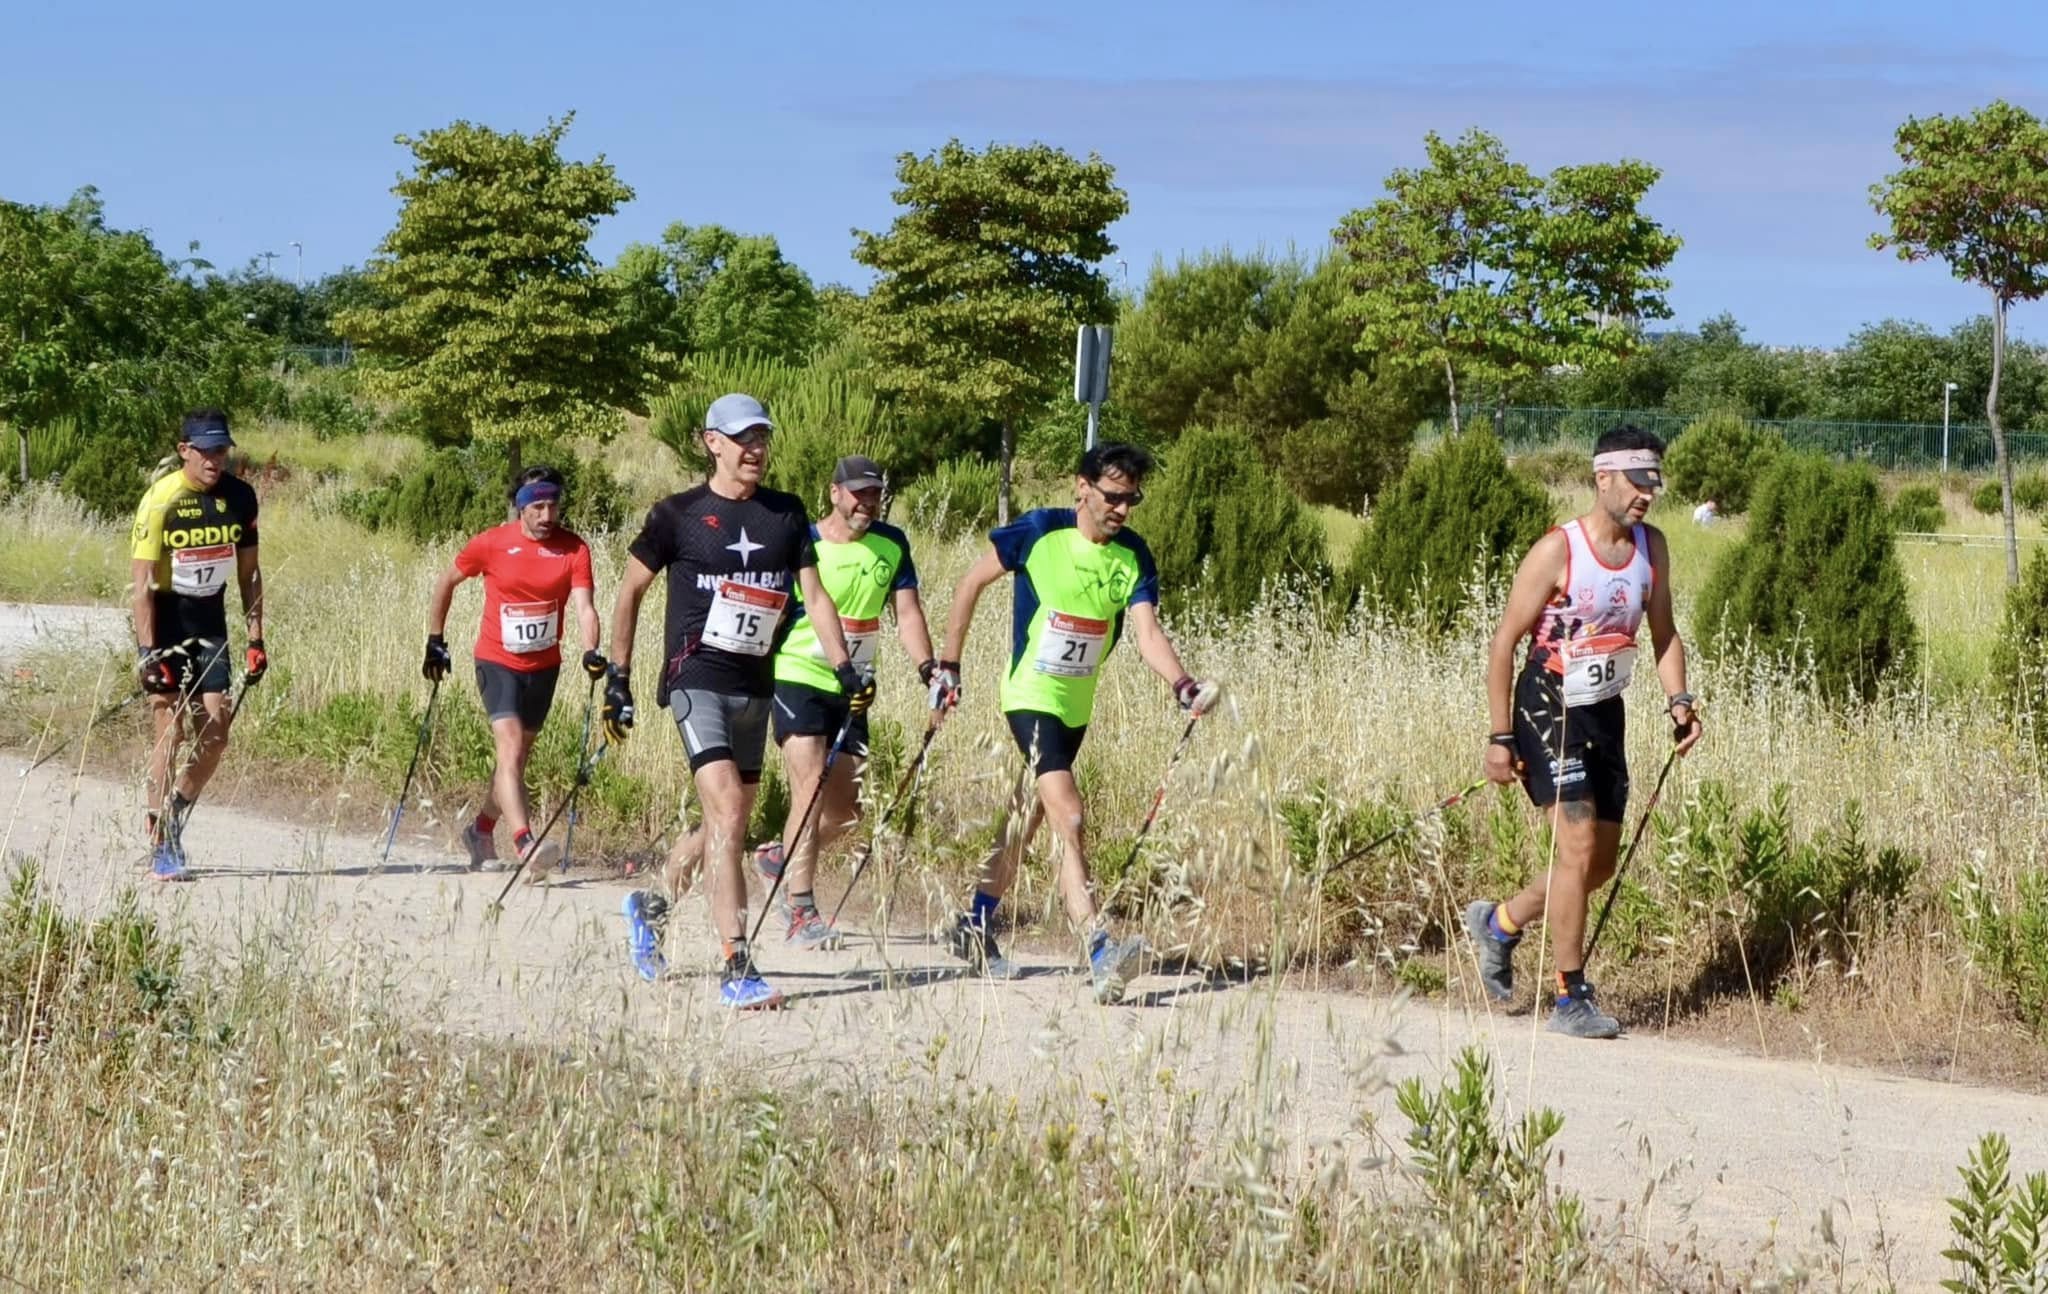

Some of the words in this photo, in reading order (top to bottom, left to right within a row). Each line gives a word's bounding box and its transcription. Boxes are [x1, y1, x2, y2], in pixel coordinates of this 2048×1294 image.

[194, 566, 215, 585] 17
[515, 621, 549, 640] 107
[735, 612, 761, 637] 15
[1061, 640, 1088, 663] 21
